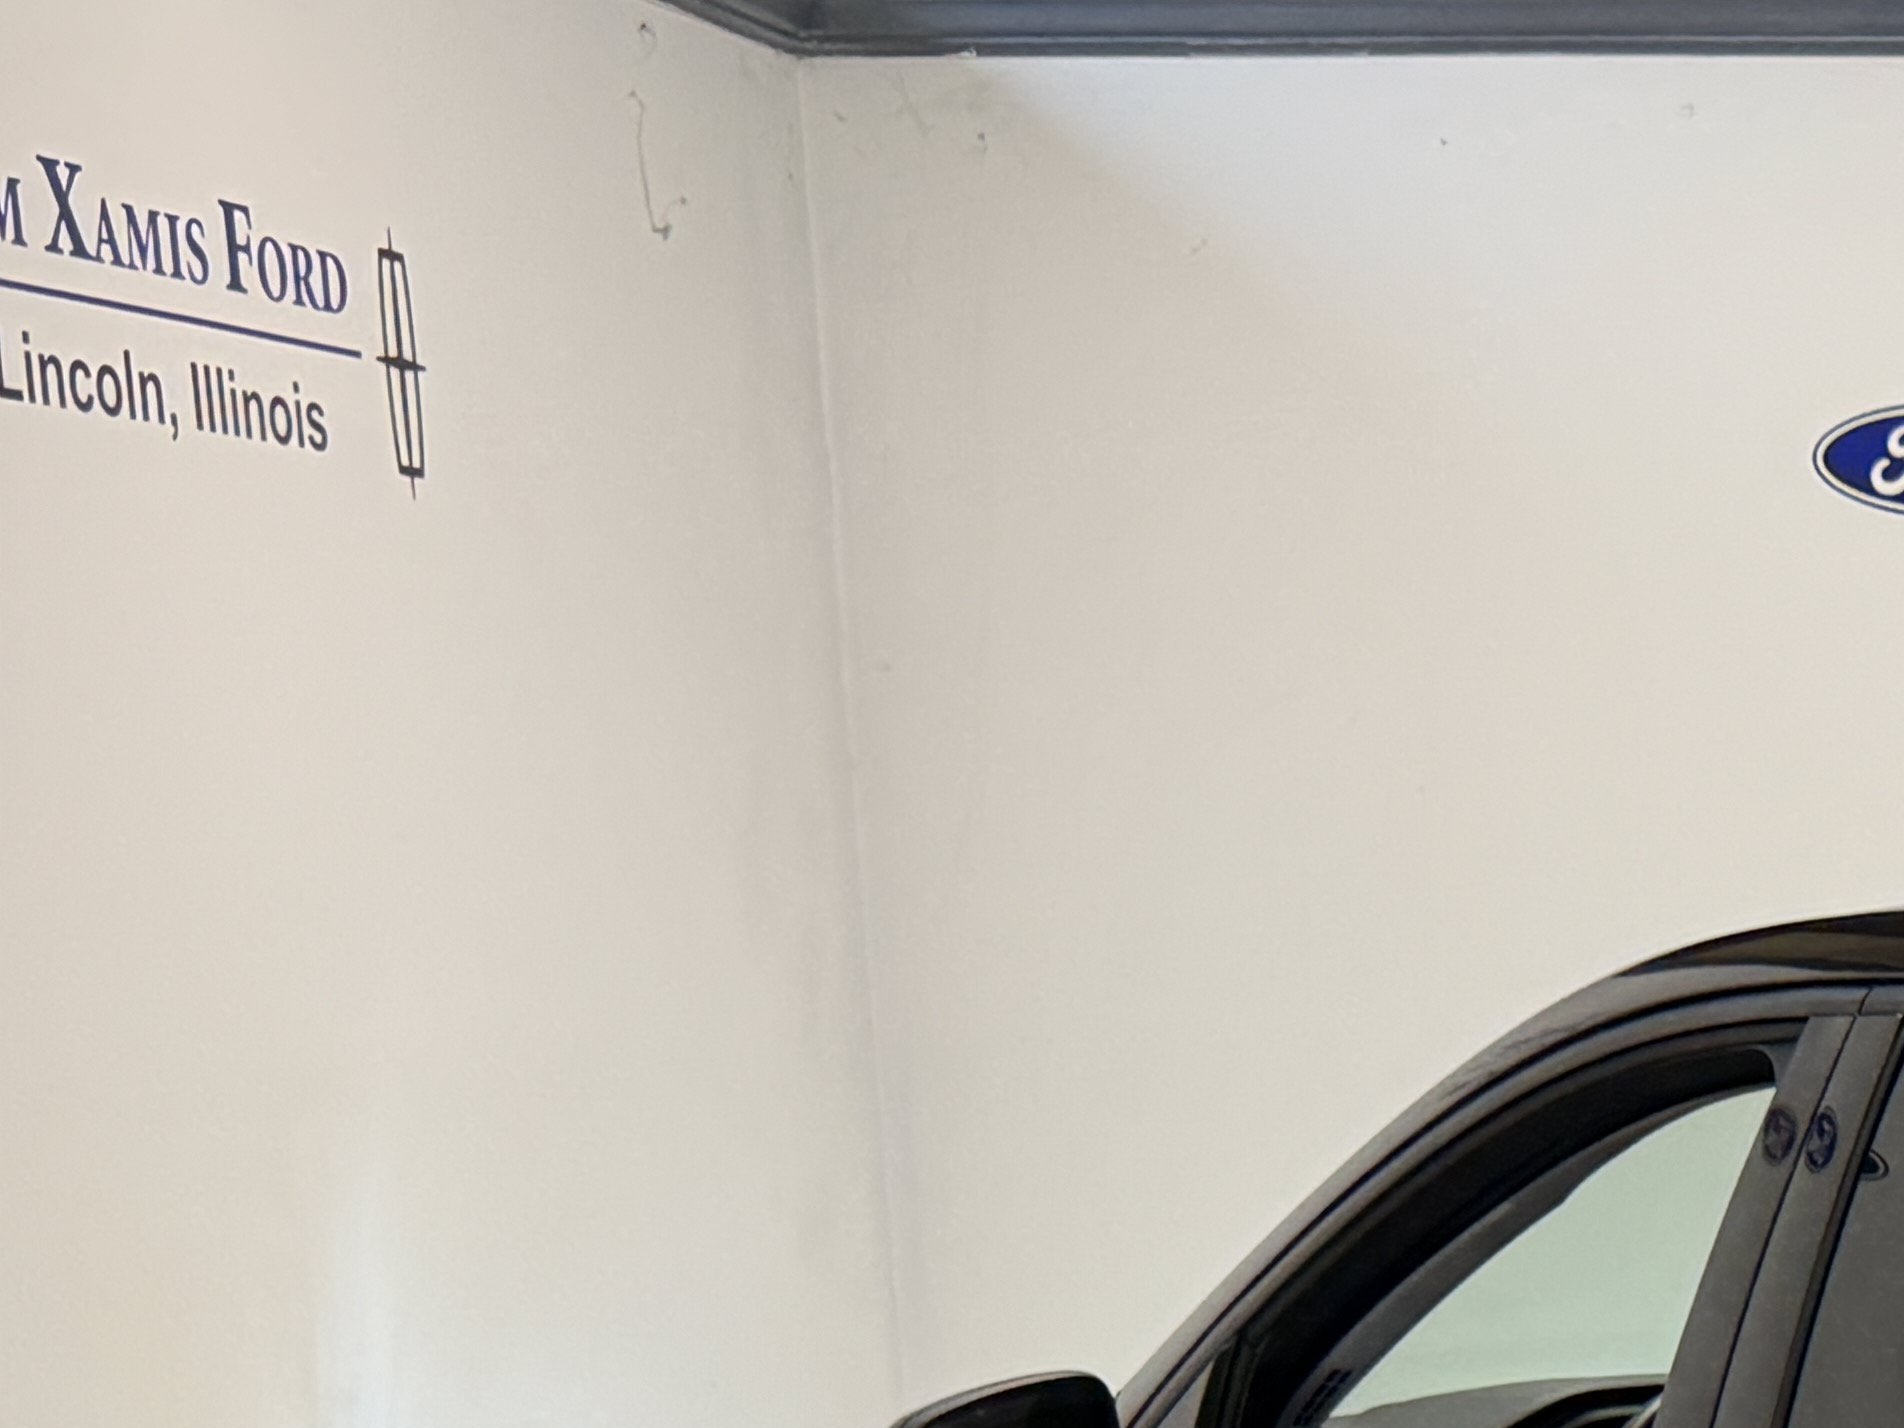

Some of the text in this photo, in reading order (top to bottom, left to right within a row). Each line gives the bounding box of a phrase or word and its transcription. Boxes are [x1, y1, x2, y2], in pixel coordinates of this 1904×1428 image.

[35, 153, 210, 286] XAMIS
[217, 199, 348, 314] FORD
[0, 329, 328, 452] Lincoln, Illinois
